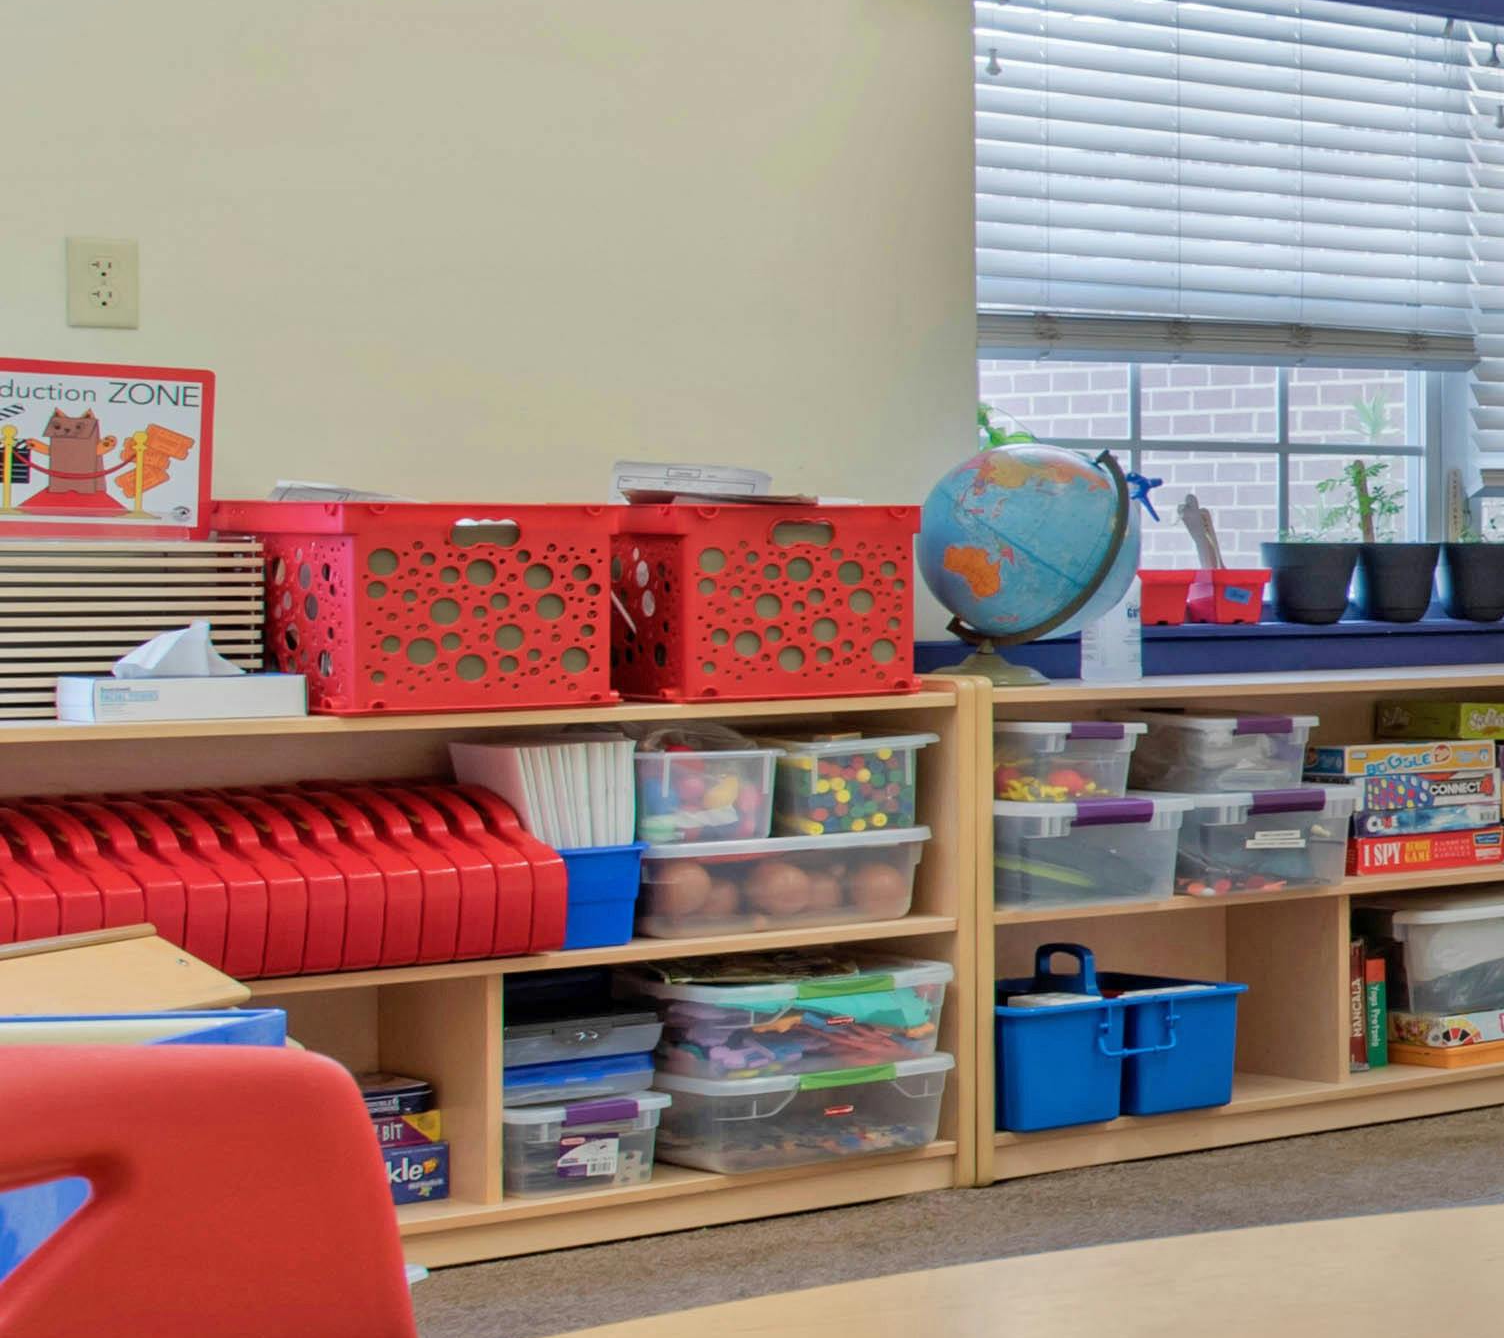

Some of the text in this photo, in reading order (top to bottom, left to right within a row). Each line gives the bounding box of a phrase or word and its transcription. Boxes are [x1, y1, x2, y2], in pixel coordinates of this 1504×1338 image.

[108, 382, 200, 408] ZONE
[1430, 774, 1495, 796] CONNECT 4
[1364, 842, 1401, 867] I SPY
[1351, 978, 1362, 1038] MANCALA
[382, 1122, 404, 1141] BIT
